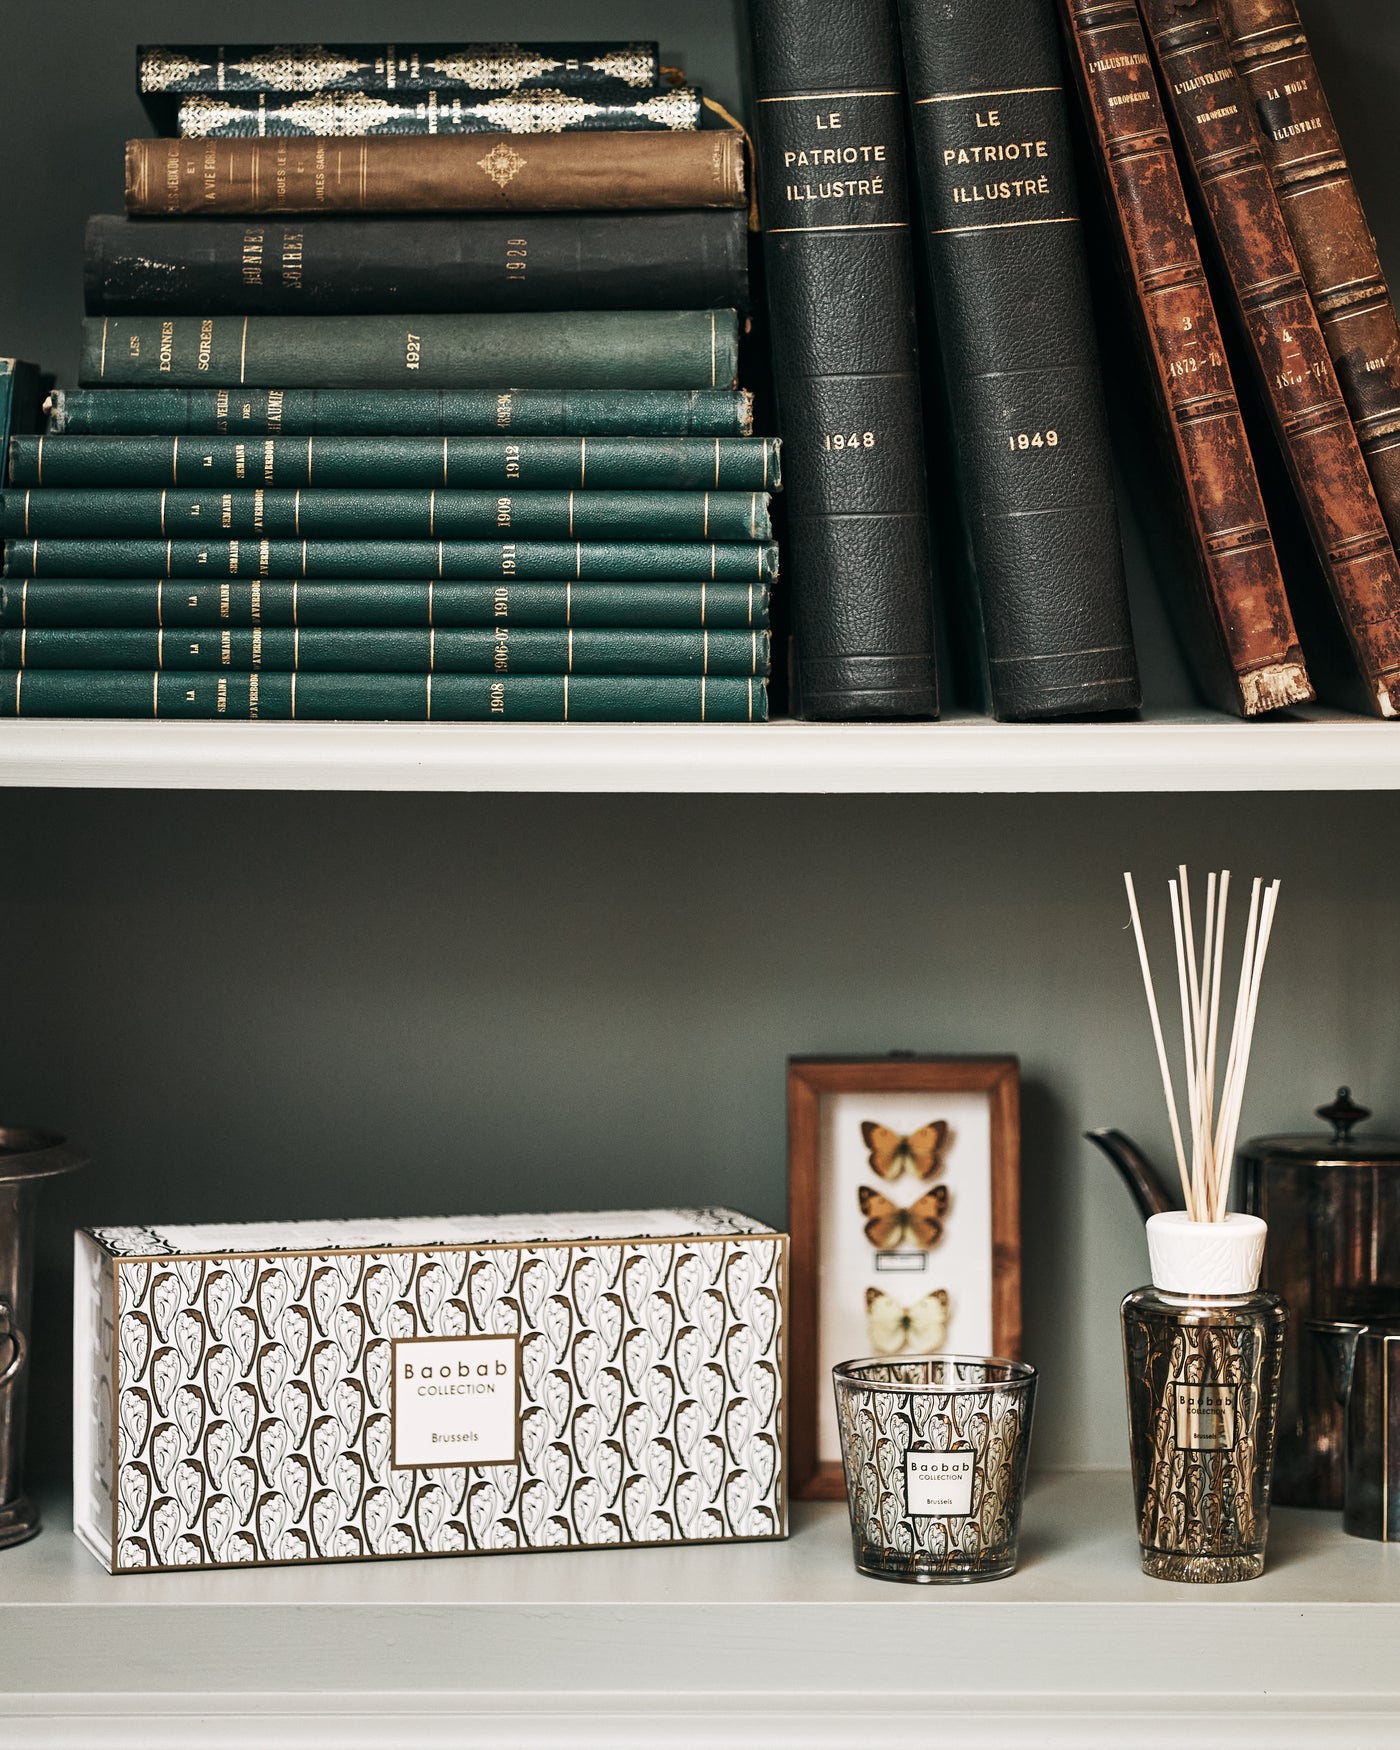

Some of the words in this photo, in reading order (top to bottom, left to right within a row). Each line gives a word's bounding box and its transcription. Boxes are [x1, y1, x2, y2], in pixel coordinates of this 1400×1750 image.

[1266, 88, 1281, 101] LA
[1284, 79, 1308, 96] MODE
[816, 111, 843, 130] LE
[975, 109, 1001, 128] LE
[784, 145, 886, 168] PATRIOTE
[943, 140, 1049, 166] PATRIOTE
[187, 161, 196, 175] ET
[204, 172, 216, 190] VIE
[786, 175, 885, 201] ILLUSTRÉ
[506, 238, 528, 281] 1929
[1182, 316, 1193, 331] 3
[1282, 328, 1293, 343] 4
[130, 335, 141, 357] LES
[406, 334, 421, 370] 1927
[243, 403, 251, 419] DES
[825, 431, 876, 451] 1948
[1009, 430, 1059, 451] 1949
[203, 455, 213, 467] LA
[235, 444, 245, 479] SEMAINE
[506, 445, 520, 479] 1912
[191, 504, 200, 515] LA
[222, 494, 232, 528] SEMAINE
[497, 497, 511, 528] 1909
[197, 551, 208, 563] LA
[229, 540, 239, 574] SEMAINE
[502, 543, 516, 575] 1911
[188, 595, 197, 607] LA
[220, 583, 230, 618] SEMAINE
[494, 588, 509, 617] 1910
[190, 643, 199, 654] LA
[221, 630, 231, 665] SEMAINE
[494, 627, 509, 673] 1906-07
[186, 690, 196, 701] LA
[217, 678, 227, 713] SEMAINE
[490, 682, 505, 713] 1908
[404, 1360, 507, 1380] Baobab
[417, 1383, 496, 1397] COLLECTION
[1179, 1395, 1232, 1406] Baobab
[1186, 1407, 1226, 1415] COLLECTION
[431, 1431, 479, 1444] Brussels
[1193, 1432, 1218, 1440] Brussels
[911, 1462, 970, 1472] Baobab
